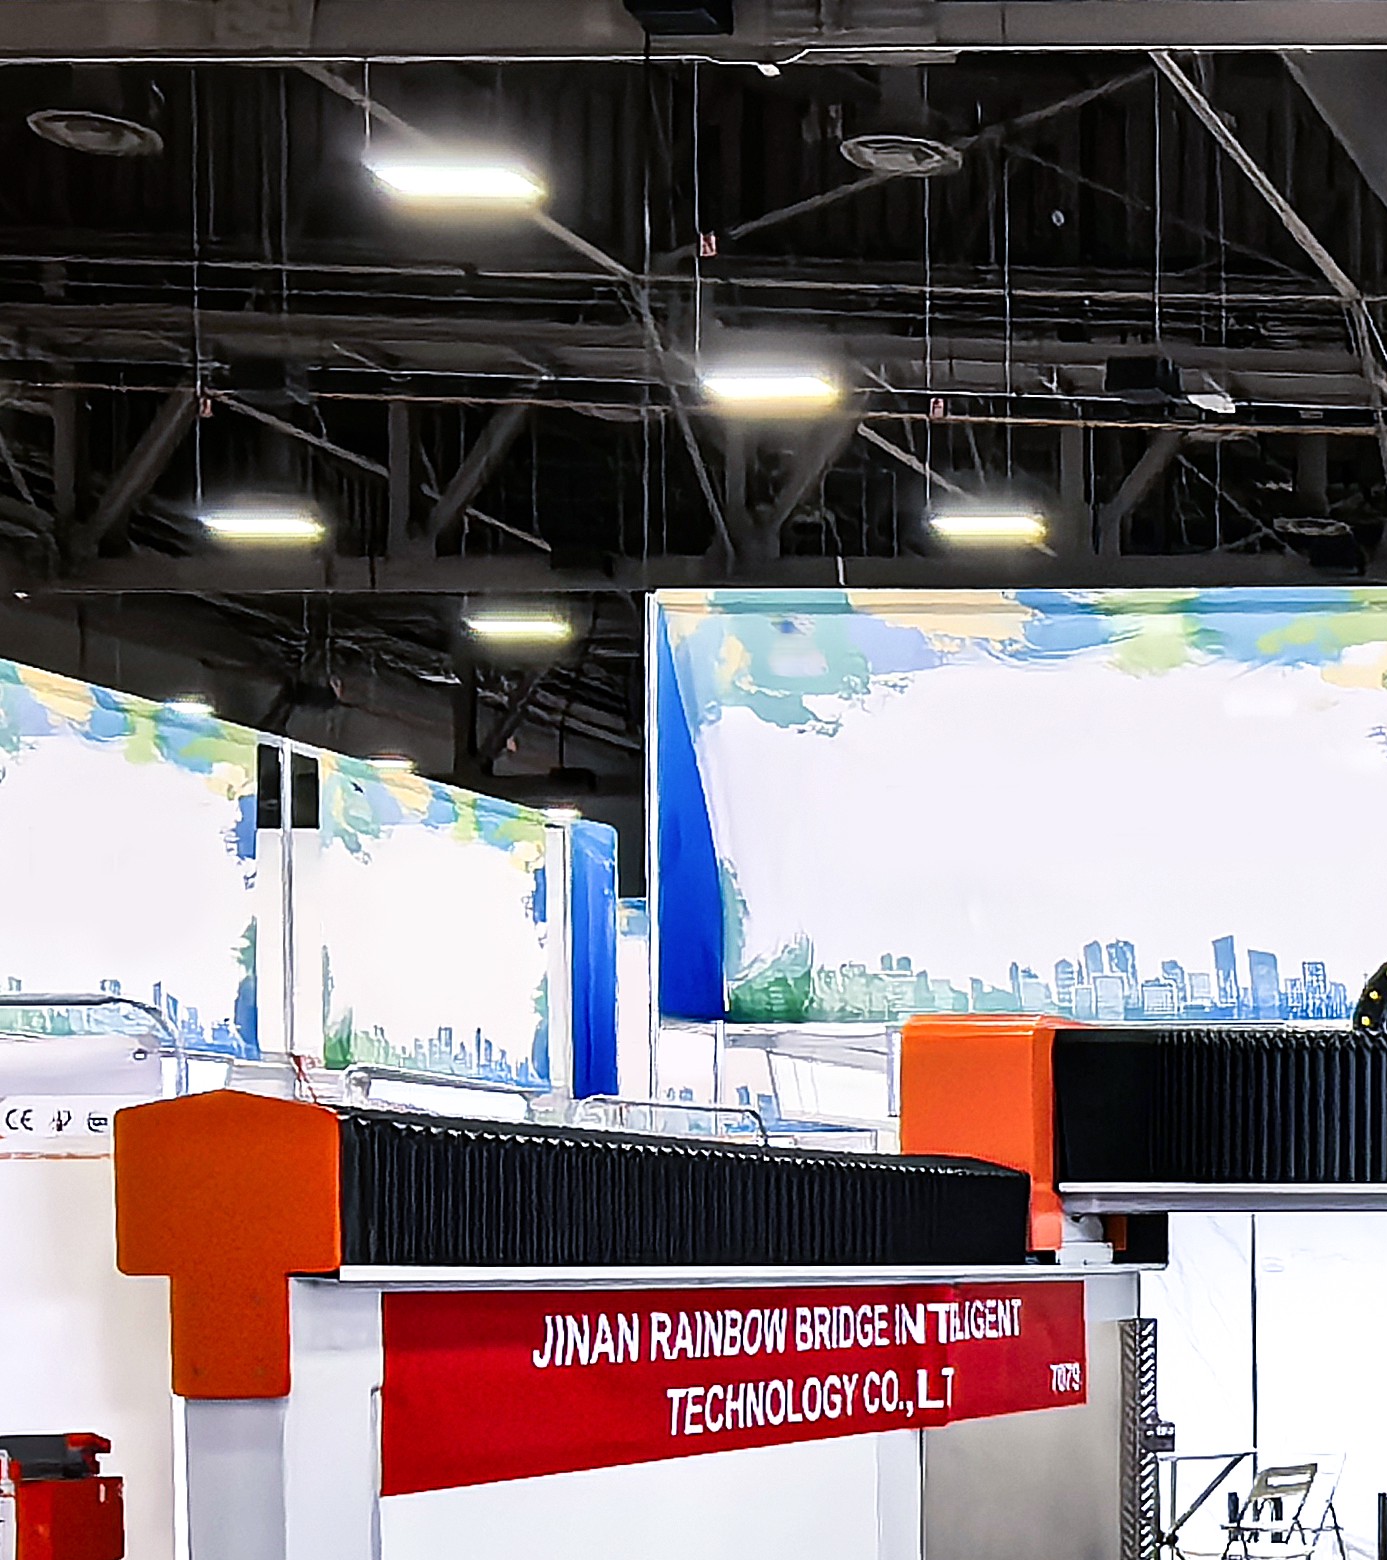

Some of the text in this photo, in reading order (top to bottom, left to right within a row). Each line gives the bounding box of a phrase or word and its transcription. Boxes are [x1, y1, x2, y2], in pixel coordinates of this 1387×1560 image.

[533, 1313, 640, 1368] JINAN
[650, 1308, 787, 1362] RAINBOW
[795, 1304, 889, 1351] BRIDGE
[666, 1374, 859, 1436] TECHNOLOGY
[863, 1369, 914, 1418] CO.,
[1050, 1362, 1081, 1393] 7079
